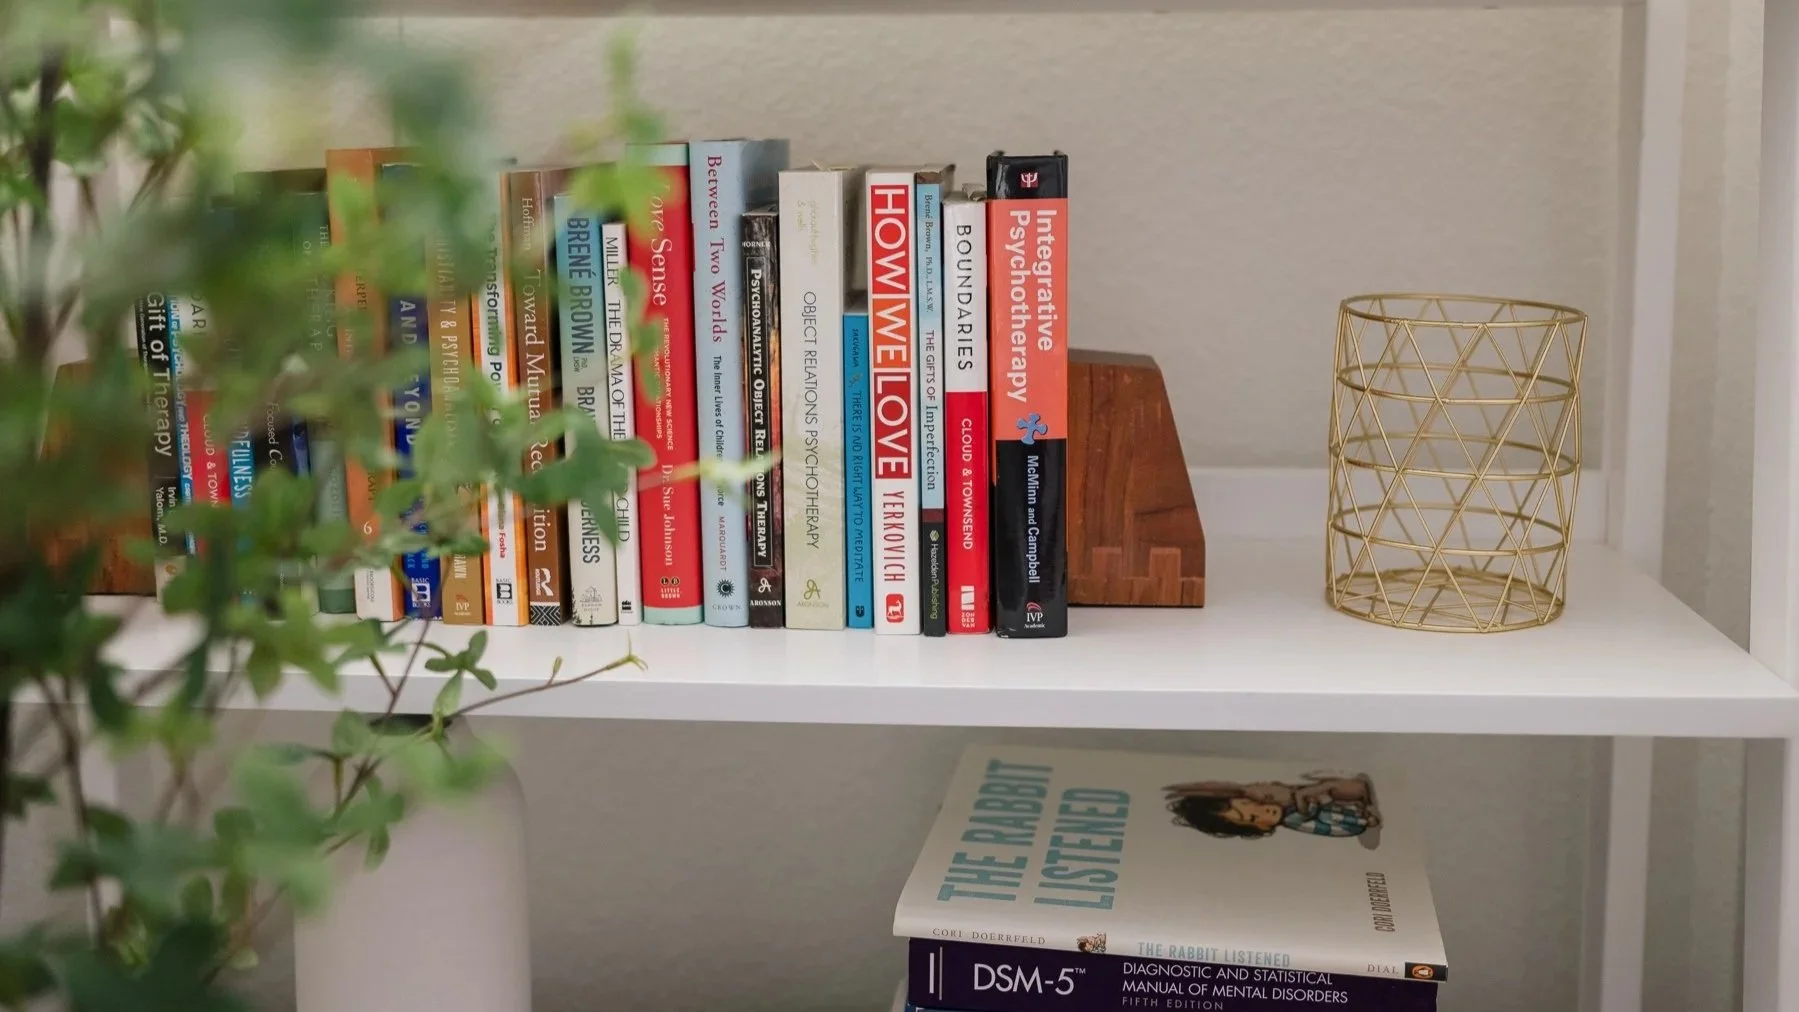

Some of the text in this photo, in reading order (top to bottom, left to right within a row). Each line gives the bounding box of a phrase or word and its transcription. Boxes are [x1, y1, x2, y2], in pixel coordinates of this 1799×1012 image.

[924, 194, 936, 219] Brené
[566, 217, 597, 280] BRENÉ
[707, 155, 728, 343] Between Two Worlds
[923, 221, 935, 253] Brown,
[651, 238, 673, 306] Sense
[956, 224, 974, 371] BOUNDARIES
[1032, 209, 1058, 352] Integrative
[401, 299, 418, 345] AND
[440, 319, 457, 329] &
[523, 269, 545, 345] Toward
[569, 284, 595, 354] BROWN
[751, 268, 764, 374] PSYCHOANALYTIC
[874, 188, 909, 475] HOW WE LOVE
[1005, 209, 1032, 403] Psychotherapy
[147, 292, 173, 457] Gift of Therapy
[526, 352, 546, 423] Mutua
[607, 237, 631, 541] MILLER THE DRAMA OF THE CHILD
[664, 334, 672, 397] REVOLUTIONARY
[713, 355, 723, 371] The
[713, 373, 724, 395] Inner
[714, 396, 725, 418] Lives
[715, 419, 725, 429] of
[753, 378, 766, 427] OBJECT
[802, 291, 820, 549] OBJECT RELATIONS PSYCHOTHERAPY
[923, 329, 941, 491] THE GIFTS OF Imperfection
[666, 418, 674, 450] SCIENCE
[715, 430, 726, 461] Childre
[206, 461, 216, 470] &
[851, 391, 865, 582] THERE IS NO RIGHT WAY TO MEDITATE
[961, 417, 975, 550] CLOUD & TOWNSEND
[155, 486, 168, 547] Yalom, M.D.
[167, 486, 178, 508] Irvin
[663, 463, 676, 566] Dr. Sue Johnson
[1026, 455, 1042, 584] McMinn and Campbell
[500, 533, 508, 559] Fosha
[718, 516, 728, 572] MARQUARDT
[756, 500, 769, 558] THERAPY
[883, 490, 906, 582] YERKOVICH
[455, 602, 470, 611] IVP
[749, 599, 782, 607] ARONSON
[1025, 611, 1043, 622] IVP
[936, 756, 1054, 902] THE RABBIT
[1033, 786, 1131, 910] LISTENED
[1365, 872, 1396, 932] CORI DOERRFELD
[932, 928, 1047, 946] CORI DOERRFELD
[1138, 942, 1291, 968] THE RABBIT LISTENED
[1122, 980, 1349, 1004] MANUAL OF MENTAL DISORDERS
[1123, 962, 1333, 985] DIAGNOSTIC AND STATISTICAL
[1367, 963, 1397, 975] DIAL
[1122, 996, 1224, 1011] FIFTH EDITION
